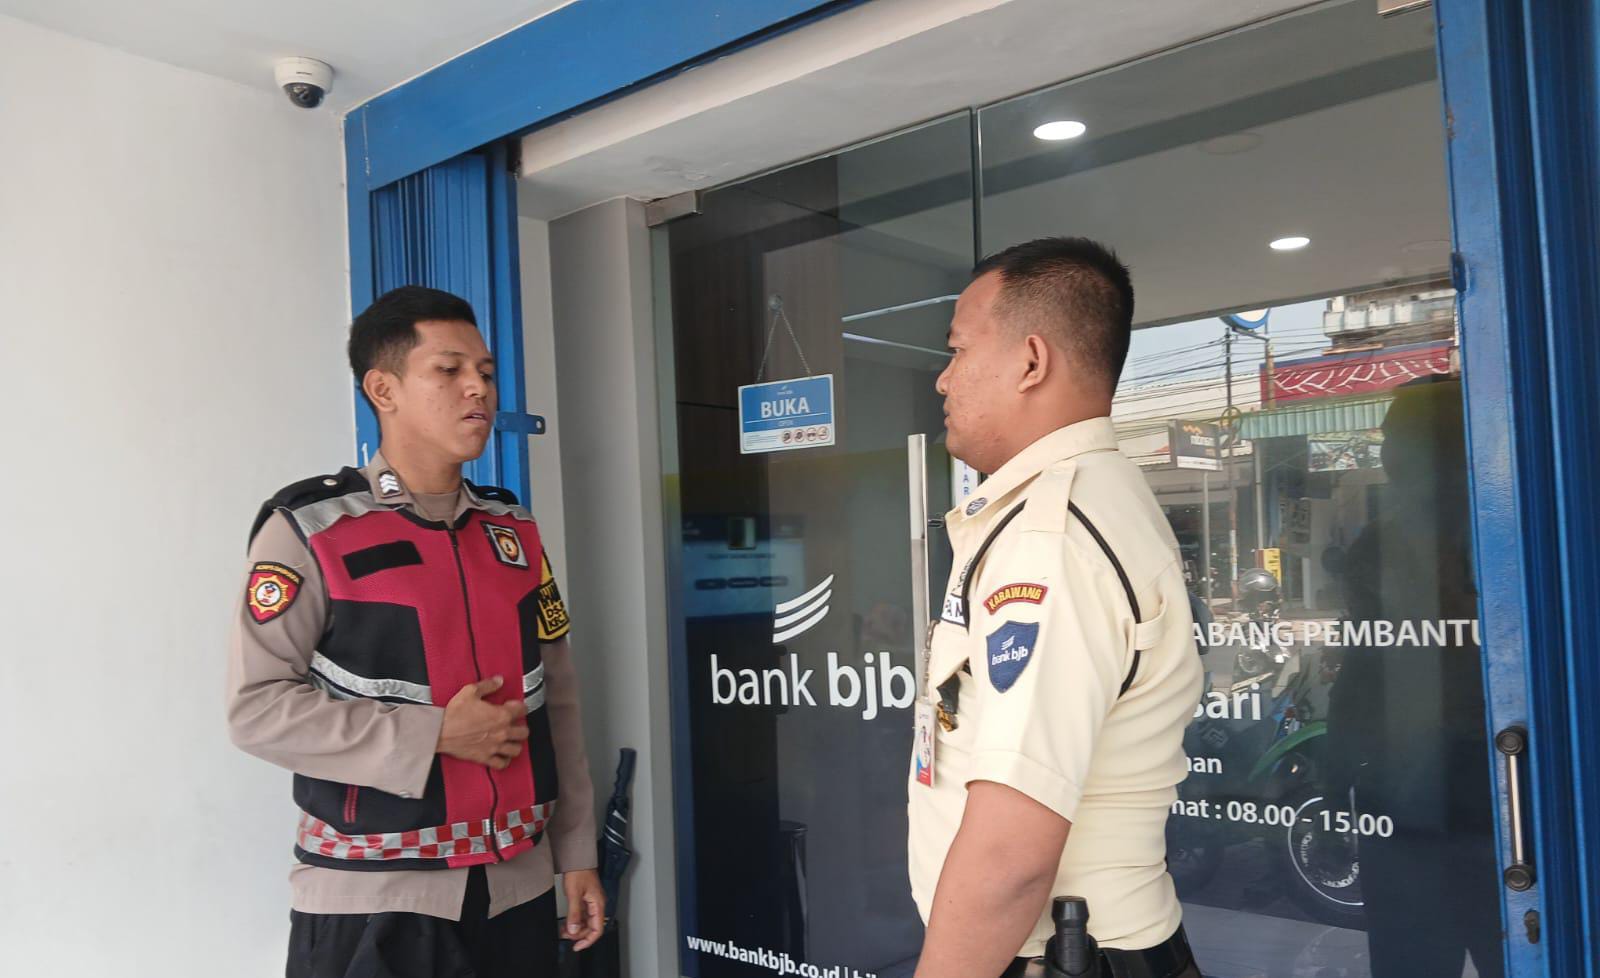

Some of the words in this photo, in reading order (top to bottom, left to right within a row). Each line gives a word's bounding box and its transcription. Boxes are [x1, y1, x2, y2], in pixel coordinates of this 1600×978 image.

[760, 397, 810, 419] BUKA
[987, 585, 1042, 609] KARAWANG
[991, 651, 1011, 666] bank
[1011, 645, 1029, 661] bjb
[710, 653, 817, 706] bank
[827, 651, 916, 721] bjb
[1226, 800, 1297, 827] 08.00
[1319, 809, 1394, 837] 15.00
